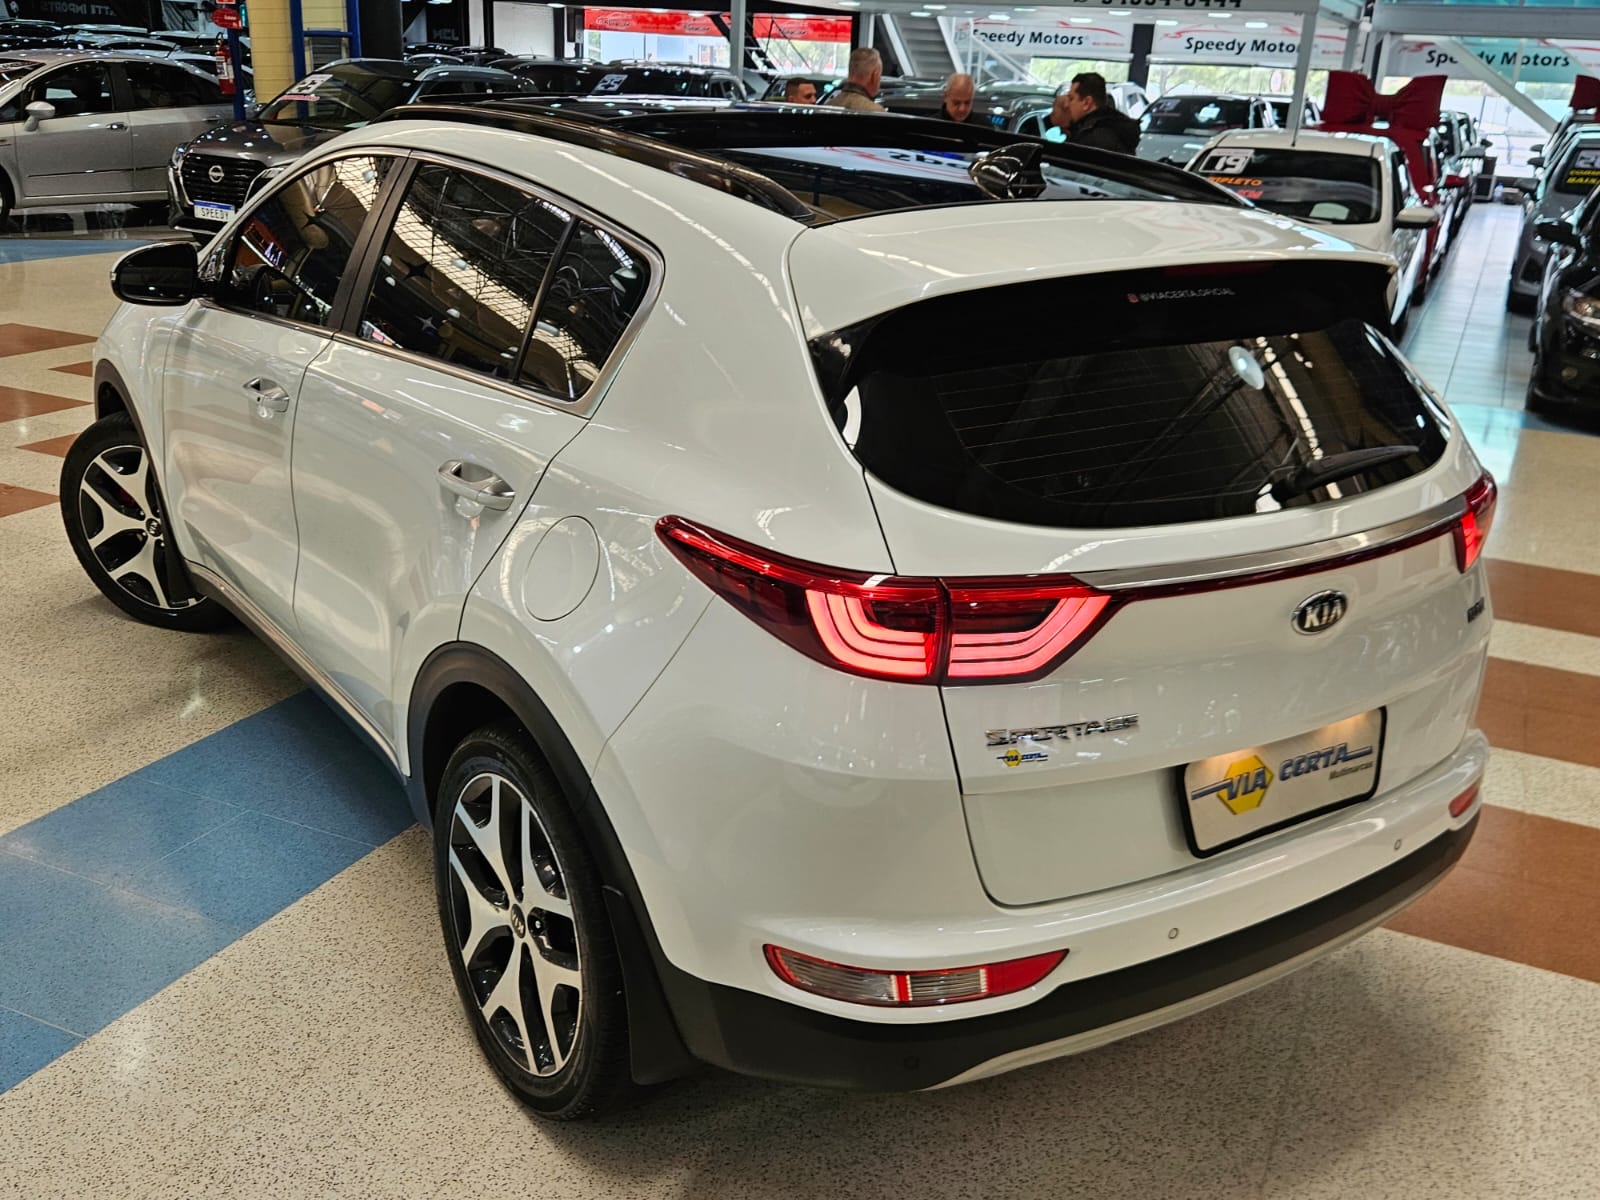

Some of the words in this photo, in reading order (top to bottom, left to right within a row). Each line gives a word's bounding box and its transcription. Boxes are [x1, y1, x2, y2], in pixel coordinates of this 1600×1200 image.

[972, 29, 1025, 46] peedy
[1029, 32, 1084, 45] Motors
[1185, 37, 1246, 55] Speedy
[1250, 40, 1300, 54] Moto
[1425, 50, 1496, 67] Spey
[1500, 52, 1570, 66] Motors
[1303, 599, 1343, 630] KIA
[985, 713, 1140, 747] SPORTAGE
[1222, 766, 1268, 801] VIA
[1279, 742, 1352, 782] CERTA
